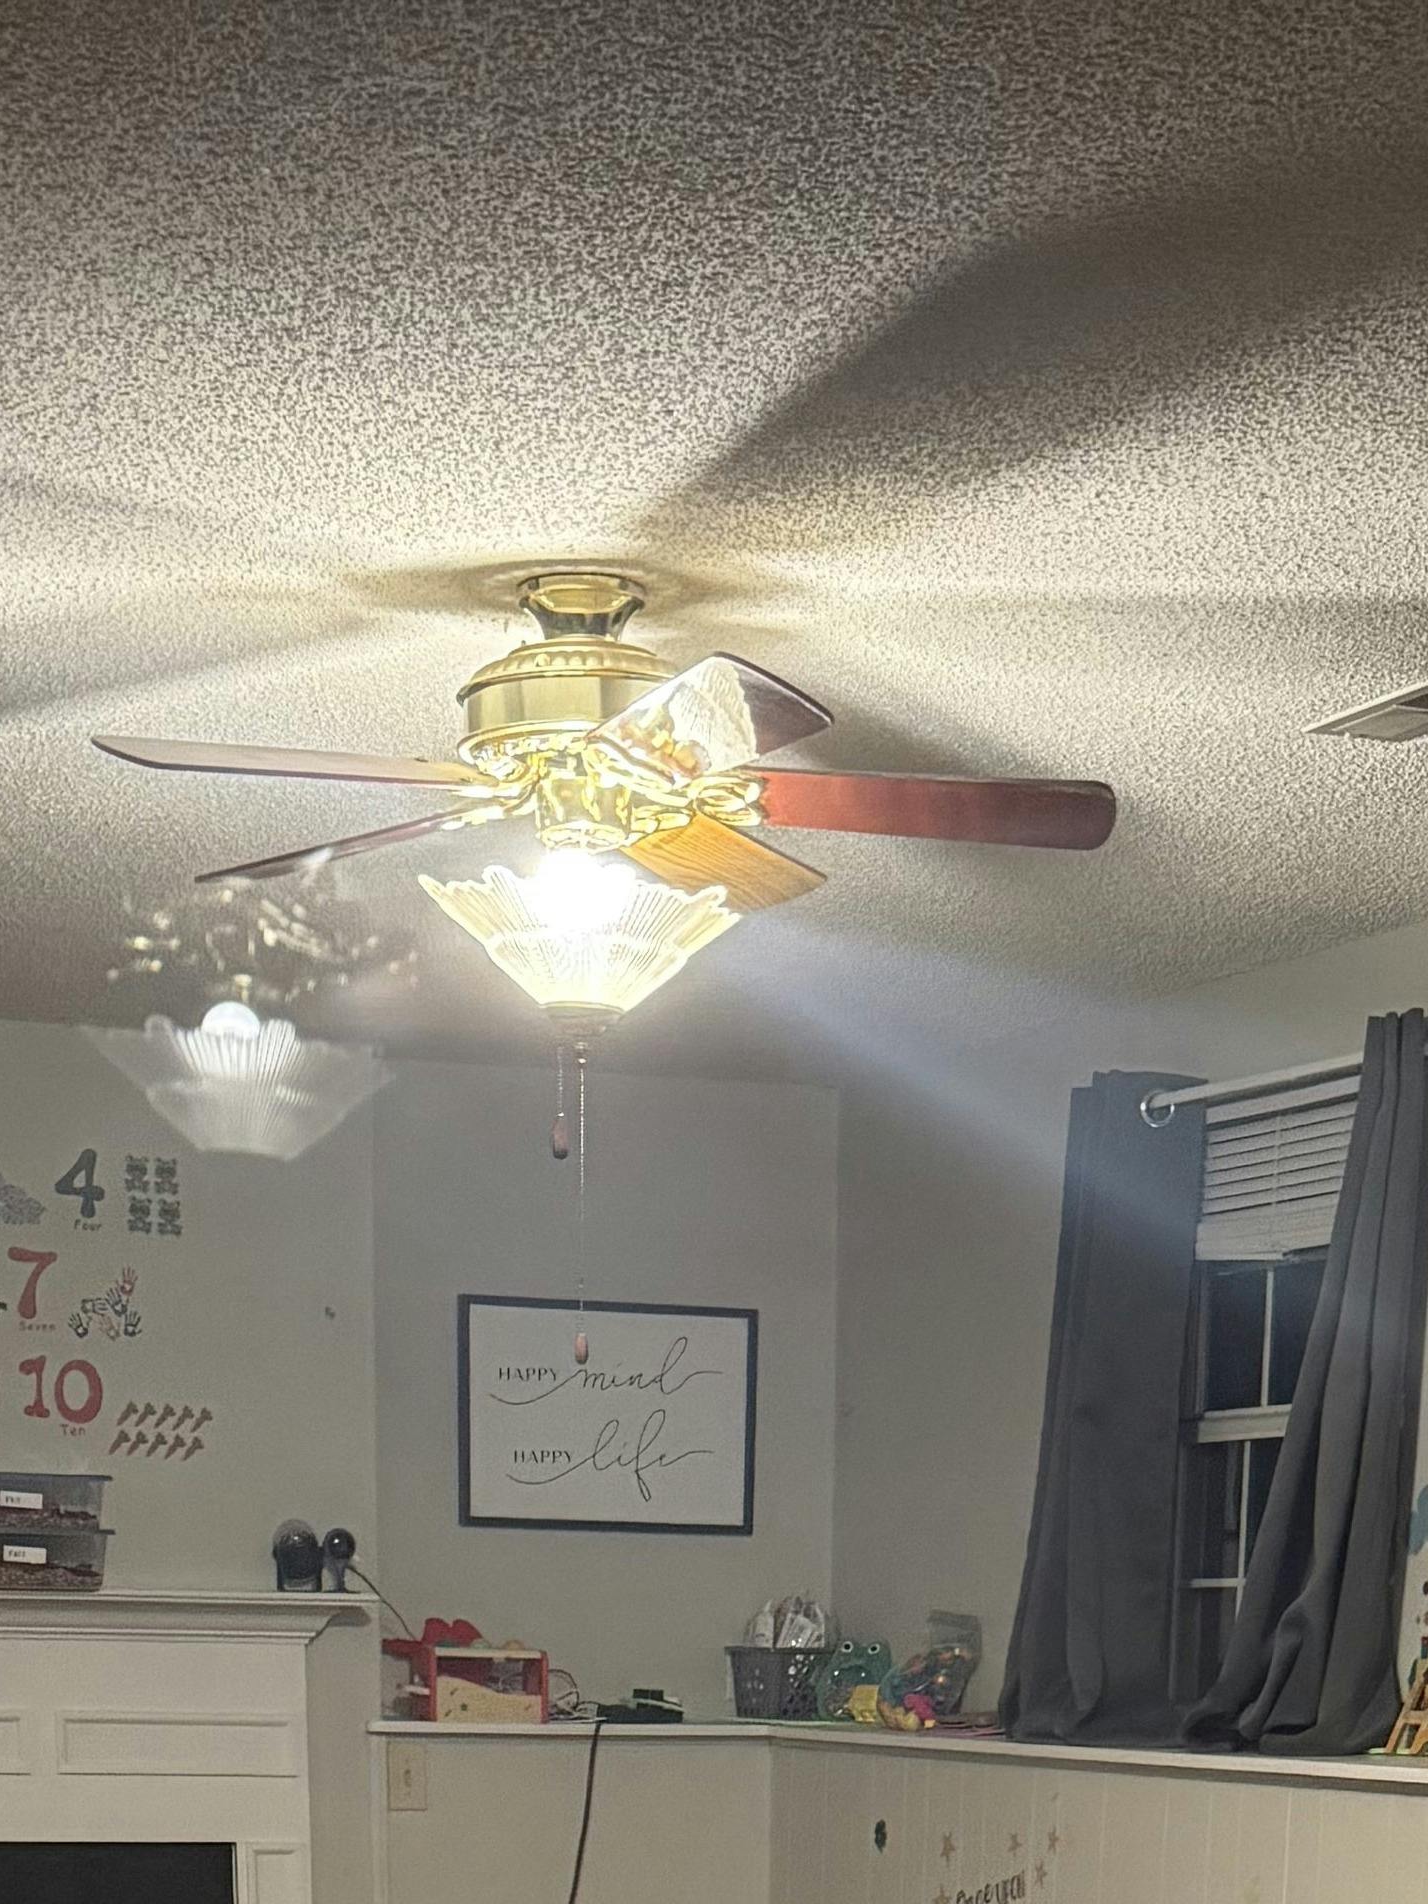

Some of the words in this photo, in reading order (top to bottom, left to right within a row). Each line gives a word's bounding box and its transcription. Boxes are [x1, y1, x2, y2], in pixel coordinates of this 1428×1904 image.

[54, 1148, 106, 1219] 4
[7, 1246, 58, 1319] 7
[18, 1354, 104, 1425] 10
[498, 1366, 557, 1382] HAPPY
[59, 1423, 86, 1437] Ten
[513, 1449, 573, 1465] HAPPY
[591, 1408, 715, 1503] life
